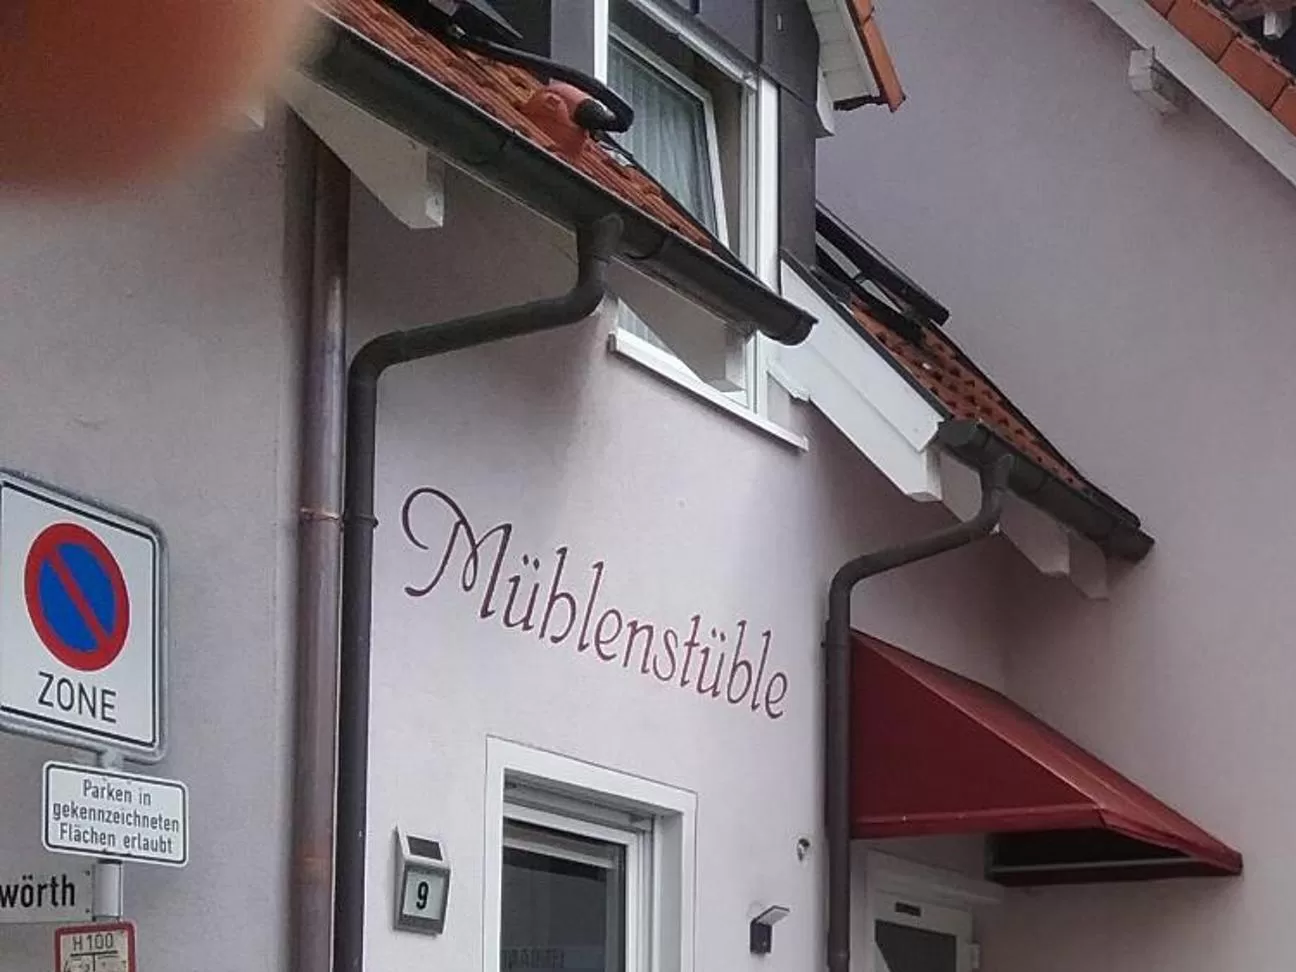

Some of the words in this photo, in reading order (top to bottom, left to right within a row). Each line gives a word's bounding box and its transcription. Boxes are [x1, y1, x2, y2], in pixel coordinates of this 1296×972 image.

[402, 487, 787, 719] Mühlenstüble
[38, 671, 117, 723] ZONE
[83, 779, 132, 803] Parken
[139, 788, 151, 805] in
[53, 801, 179, 832] gekennzeichneten
[60, 822, 116, 847] Flächen
[123, 833, 172, 854] erlaubt
[415, 881, 429, 909] 9
